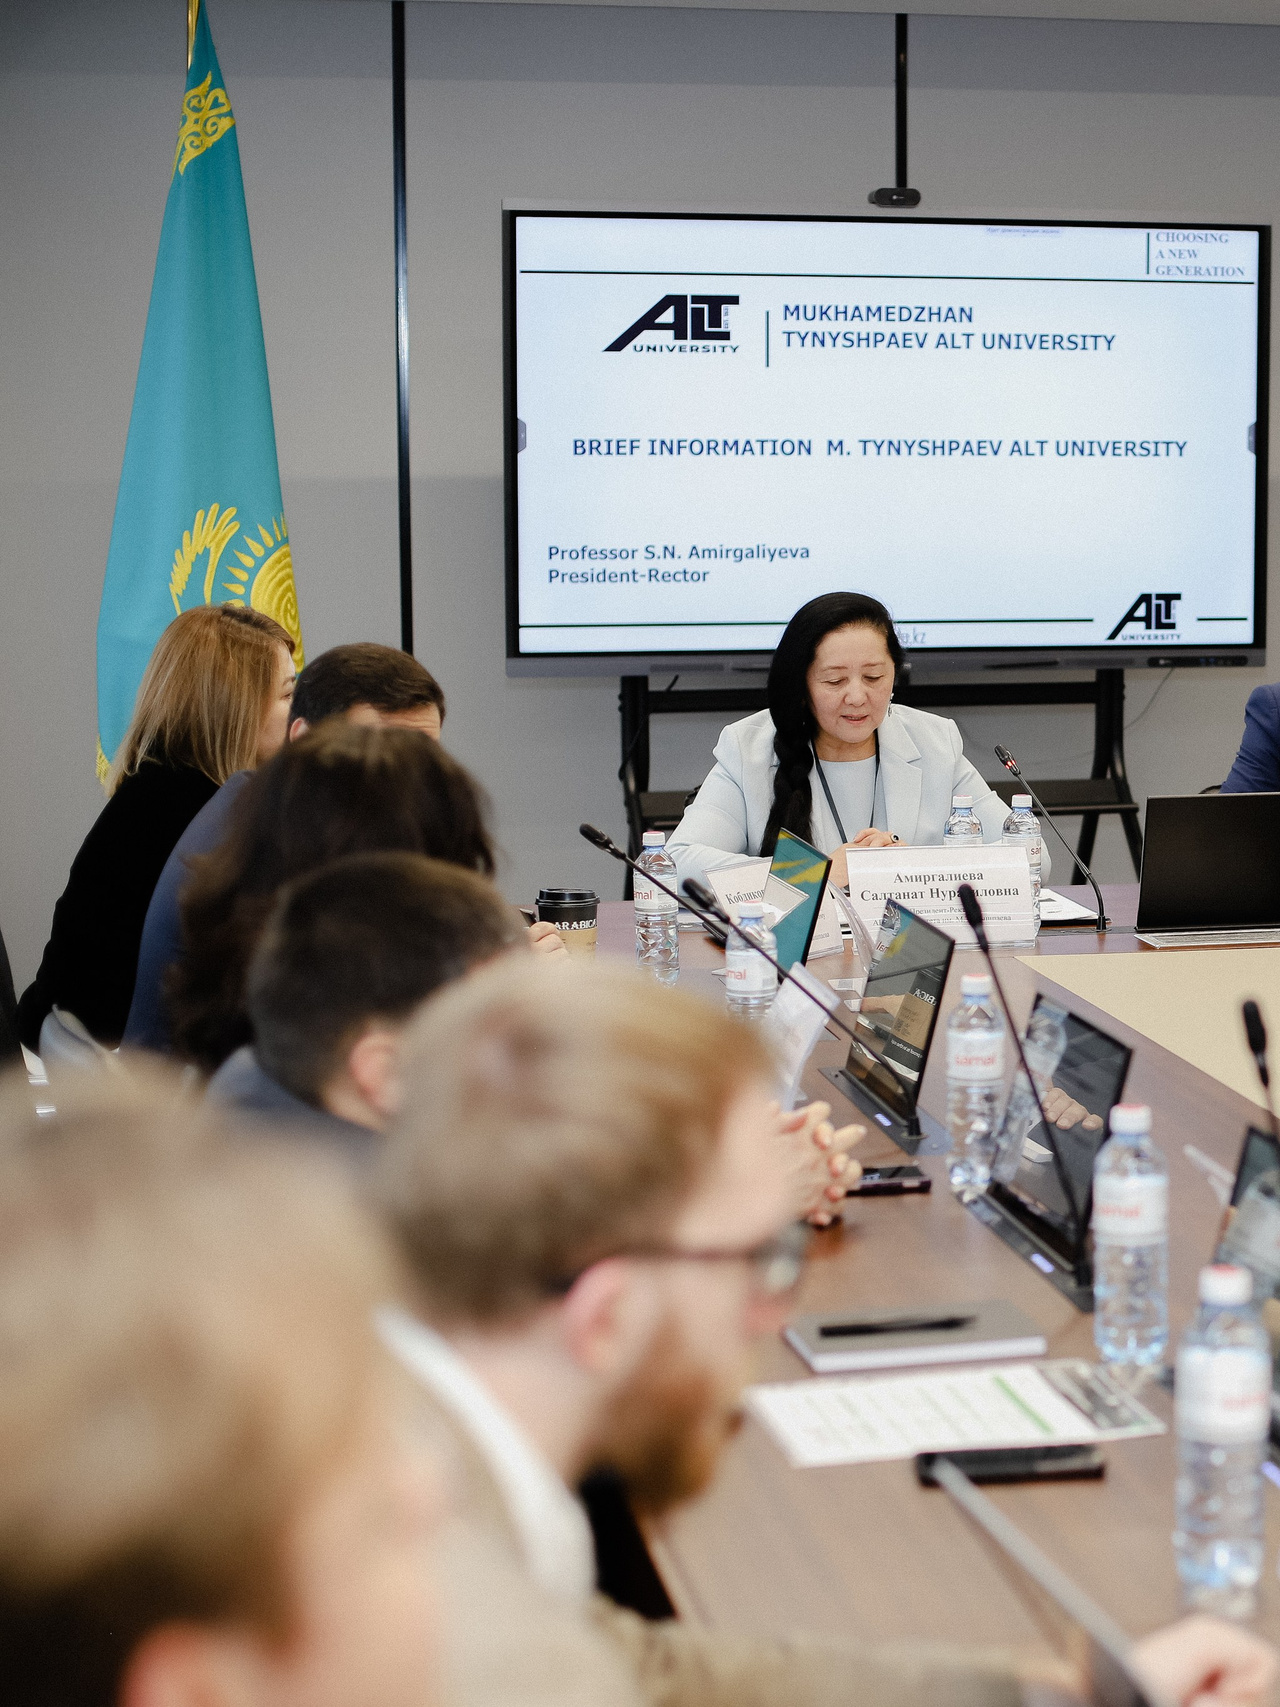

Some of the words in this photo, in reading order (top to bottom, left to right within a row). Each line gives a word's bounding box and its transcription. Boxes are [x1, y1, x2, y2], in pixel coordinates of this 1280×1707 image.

[1155, 231, 1229, 244] CHOOSING
[1155, 249, 1165, 259] A
[1168, 249, 1199, 260] NEW
[1155, 265, 1245, 277] GENERATION
[783, 304, 973, 323] MUKHAMEDZHAN
[603, 294, 740, 352] ALT
[783, 331, 928, 349] TYNYSHPAEV
[935, 333, 975, 349] ALT
[982, 333, 1116, 351] UNIVERSITY
[633, 344, 740, 353] UNIVERSITY
[573, 439, 641, 456] BRIEF
[648, 439, 812, 456] INFORMATION
[827, 439, 851, 456] M.
[859, 439, 1003, 456] TYNYSHPAEV
[1009, 440, 1049, 456] ALT
[1056, 440, 1187, 457] UNIVERSITY
[549, 545, 638, 560] Professor
[644, 545, 681, 560] S.N.
[688, 544, 810, 563] Amirgaliyeva
[549, 568, 710, 583] President-Rector
[1105, 592, 1182, 641] ALT
[1121, 633, 1182, 641] UNIVERSITY
[893, 872, 984, 885] Амиргалиева
[860, 890, 926, 901] Салтанат
